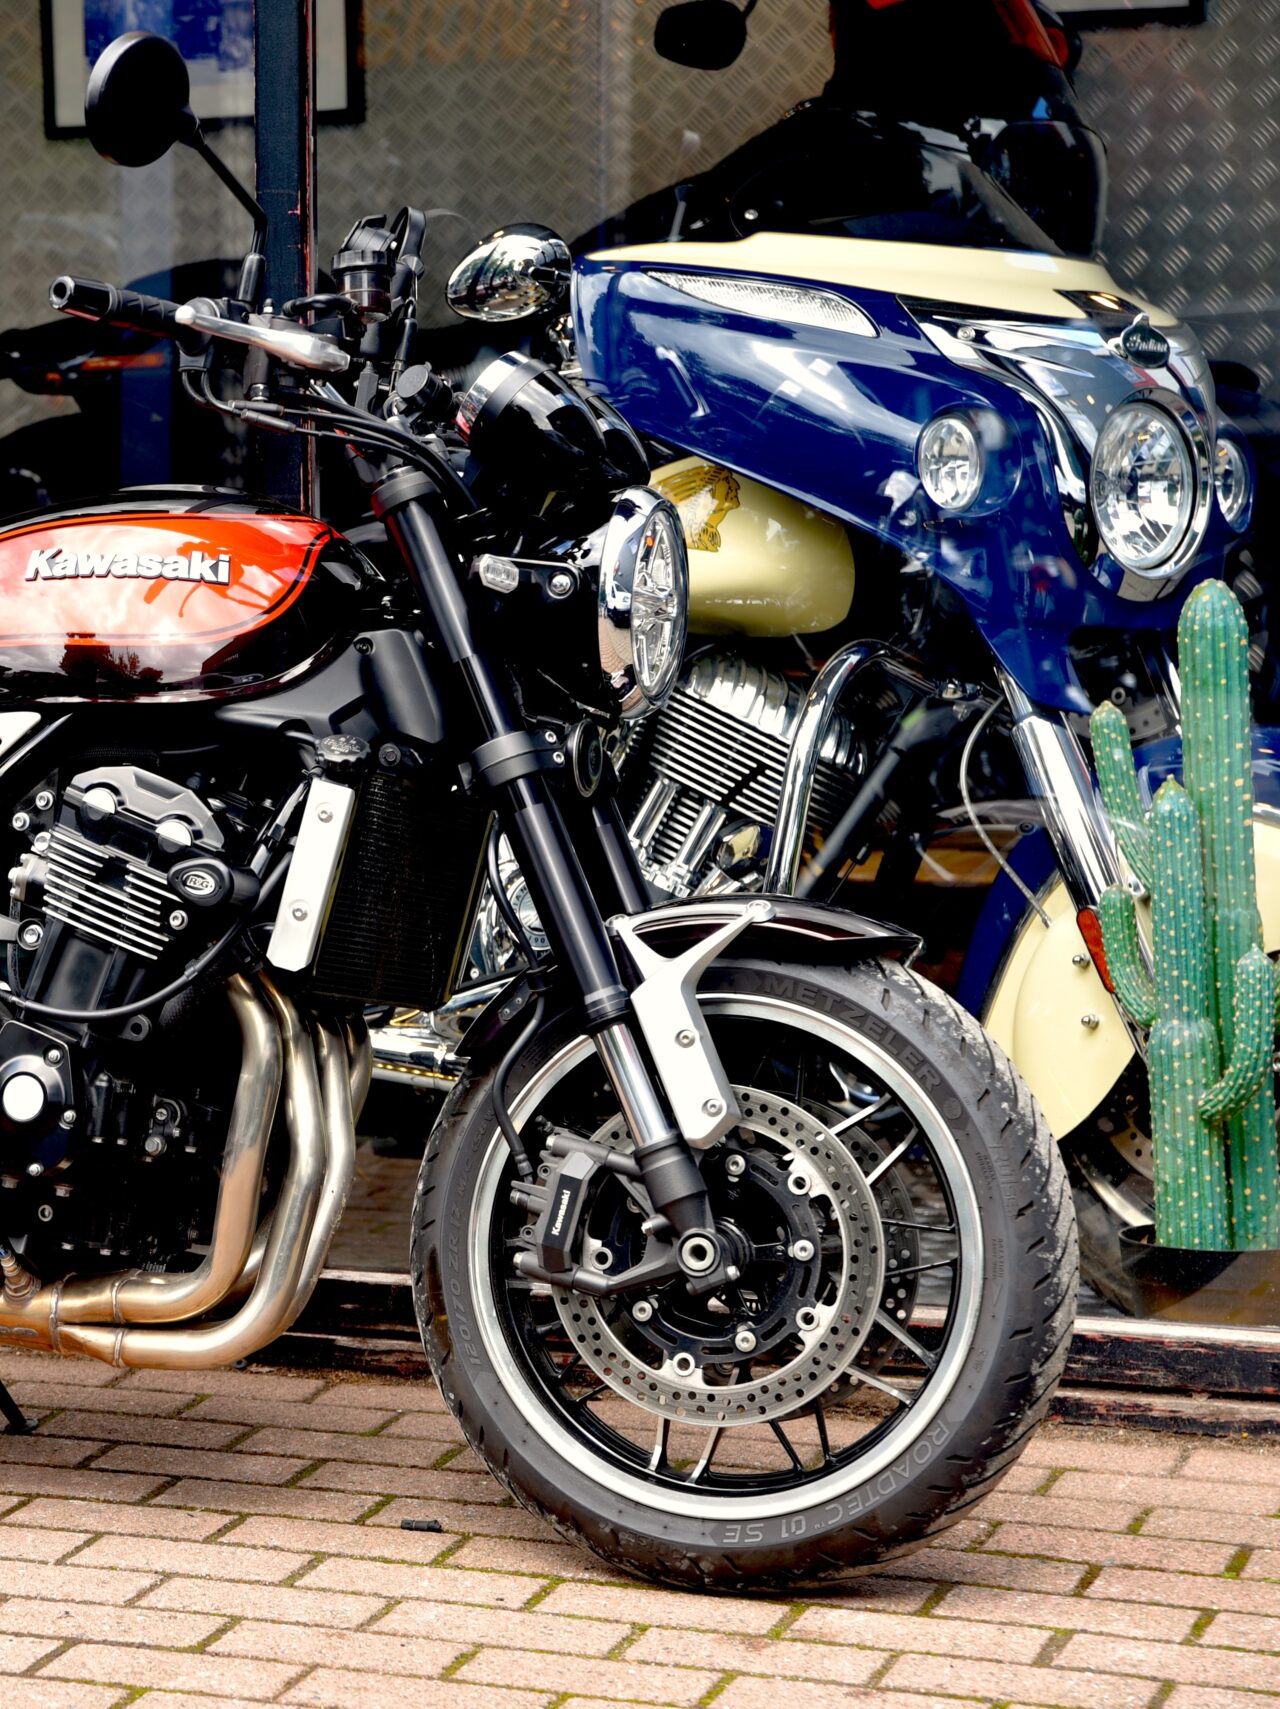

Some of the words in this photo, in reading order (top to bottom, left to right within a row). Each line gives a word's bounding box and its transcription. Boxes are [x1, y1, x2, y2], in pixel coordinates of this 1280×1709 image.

[24, 548, 230, 586] Kawasaki
[763, 974, 942, 1095] METZELER
[551, 1189, 571, 1236] Kawasaki
[448, 1231, 461, 1272] ZR
[450, 1278, 482, 1366] 120/70
[722, 1523, 765, 1543] SE
[780, 1515, 807, 1539] 01
